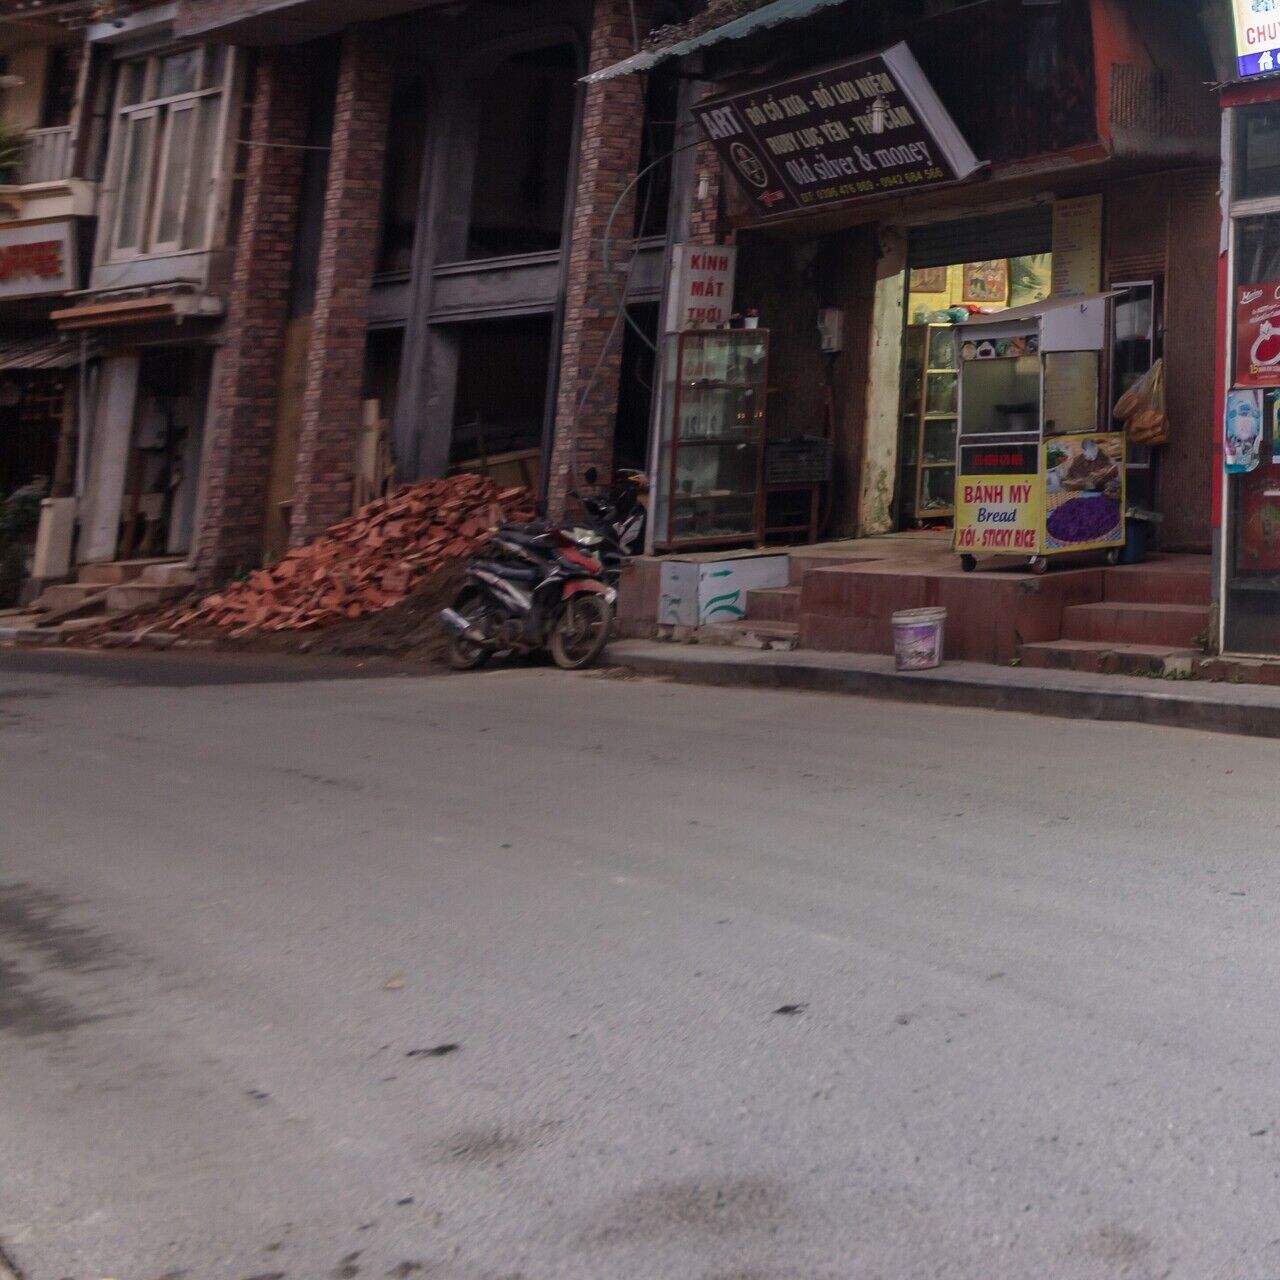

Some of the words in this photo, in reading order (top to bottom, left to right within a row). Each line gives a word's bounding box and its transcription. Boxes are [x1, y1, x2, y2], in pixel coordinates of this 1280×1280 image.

[700, 105, 743, 140] ART
[813, 148, 859, 179] silver
[873, 140, 934, 167] money
[964, 480, 1004, 504] BÁNH
[976, 506, 1017, 523] Bread
[981, 527, 1014, 548] STICKY
[1014, 528, 1036, 548] RICE
